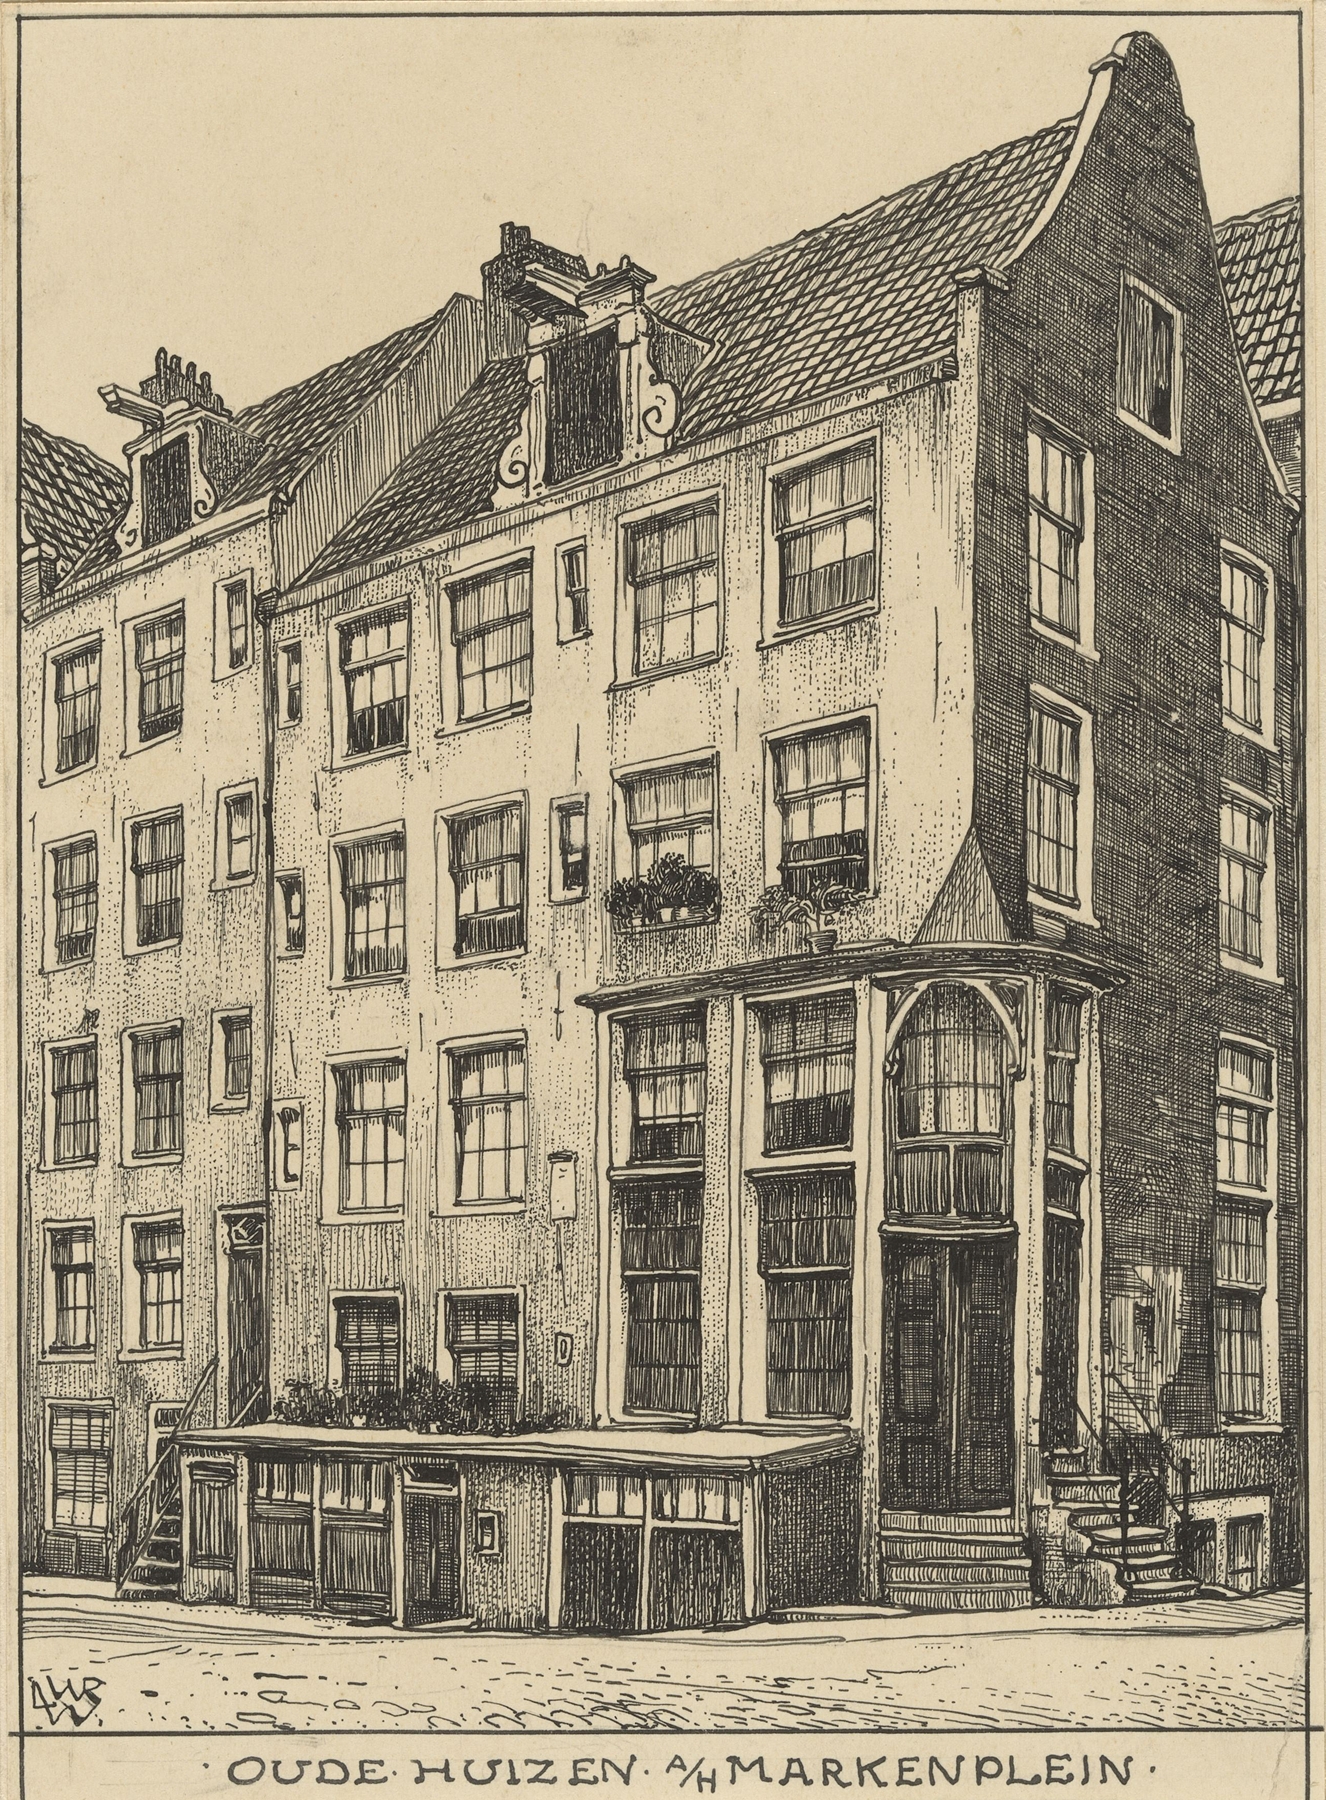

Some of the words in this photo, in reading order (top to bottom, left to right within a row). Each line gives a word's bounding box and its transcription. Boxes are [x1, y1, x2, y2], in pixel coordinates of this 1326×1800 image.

[227, 1756, 389, 1786] OUDE
[411, 1754, 638, 1787] HUIZEN
[725, 1753, 1134, 1789] MARKENPLEIN
